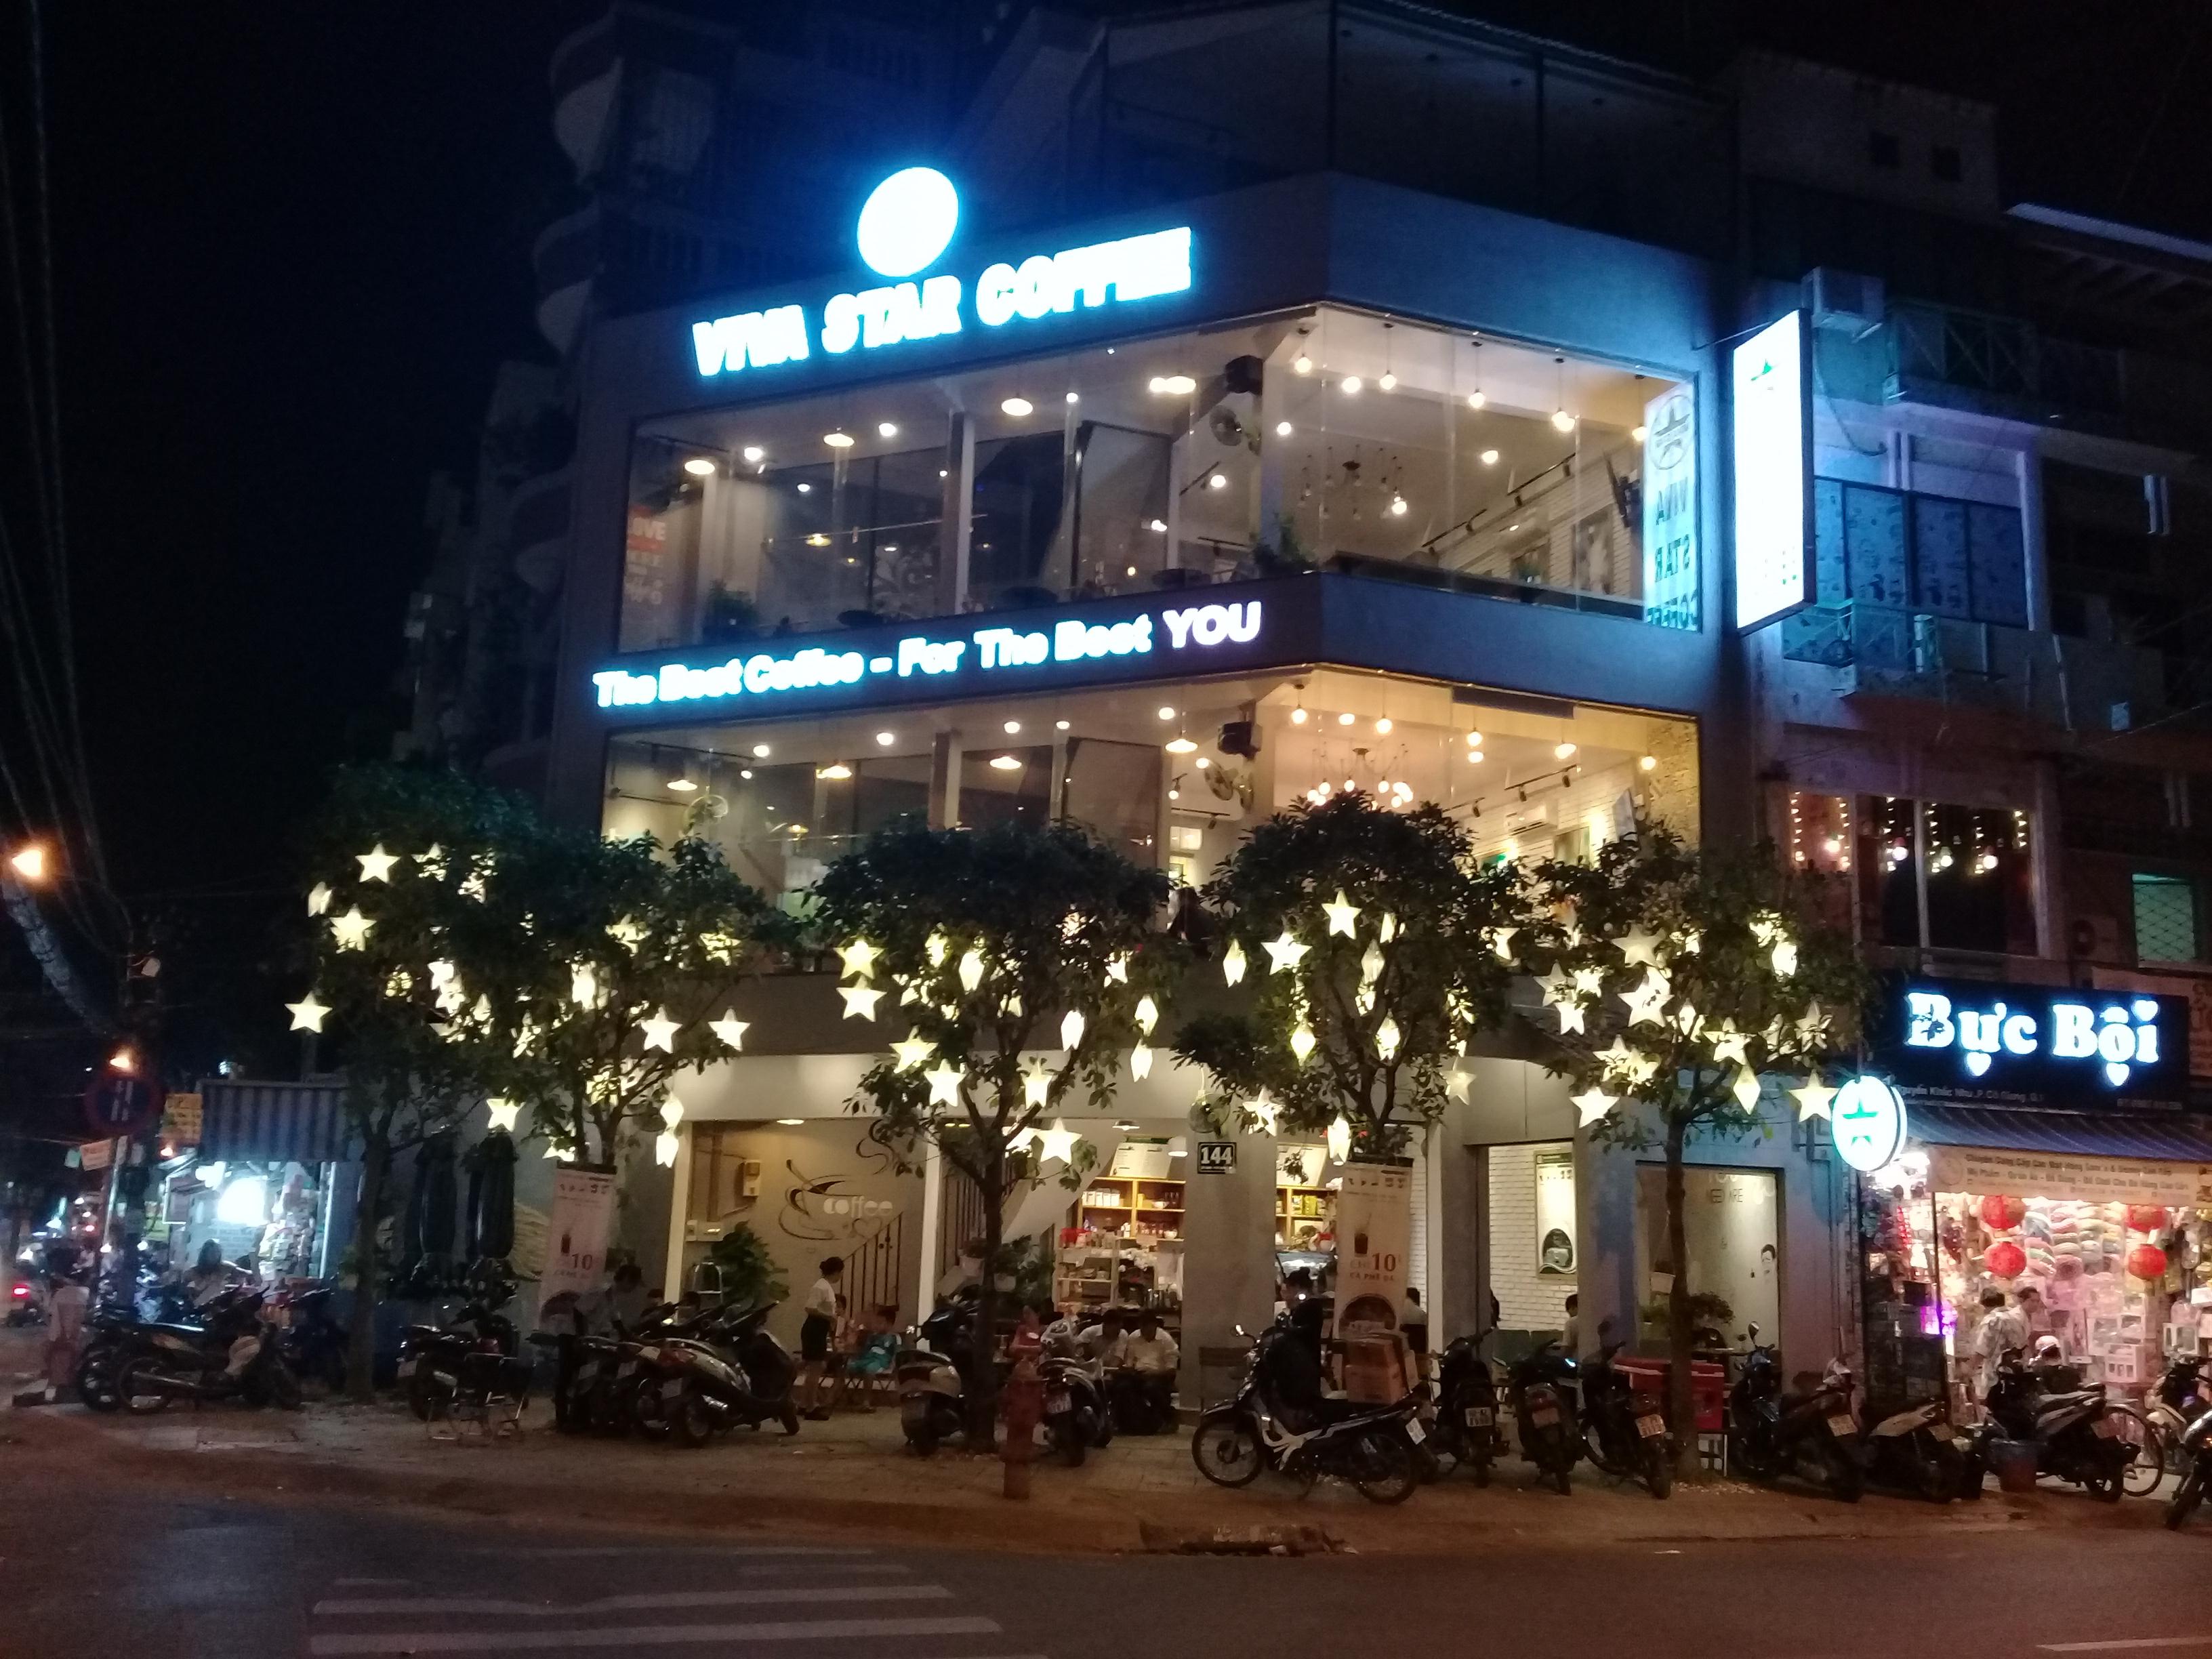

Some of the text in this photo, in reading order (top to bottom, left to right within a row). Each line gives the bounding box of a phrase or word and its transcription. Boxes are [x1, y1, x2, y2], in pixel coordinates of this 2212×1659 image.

[821, 274, 962, 354] STAR
[592, 670, 658, 708] The
[657, 657, 744, 702] Best
[743, 647, 865, 694] Coffee
[897, 636, 966, 678] For
[972, 627, 1050, 669] The
[1054, 613, 1153, 661] Best
[1162, 600, 1263, 649] YOU
[1905, 991, 2038, 1077] Bực
[2052, 999, 2160, 1087] Bội
[1201, 1146, 1232, 1165] 144
[571, 1252, 592, 1271] 10
[1372, 1252, 1396, 1272] 10
